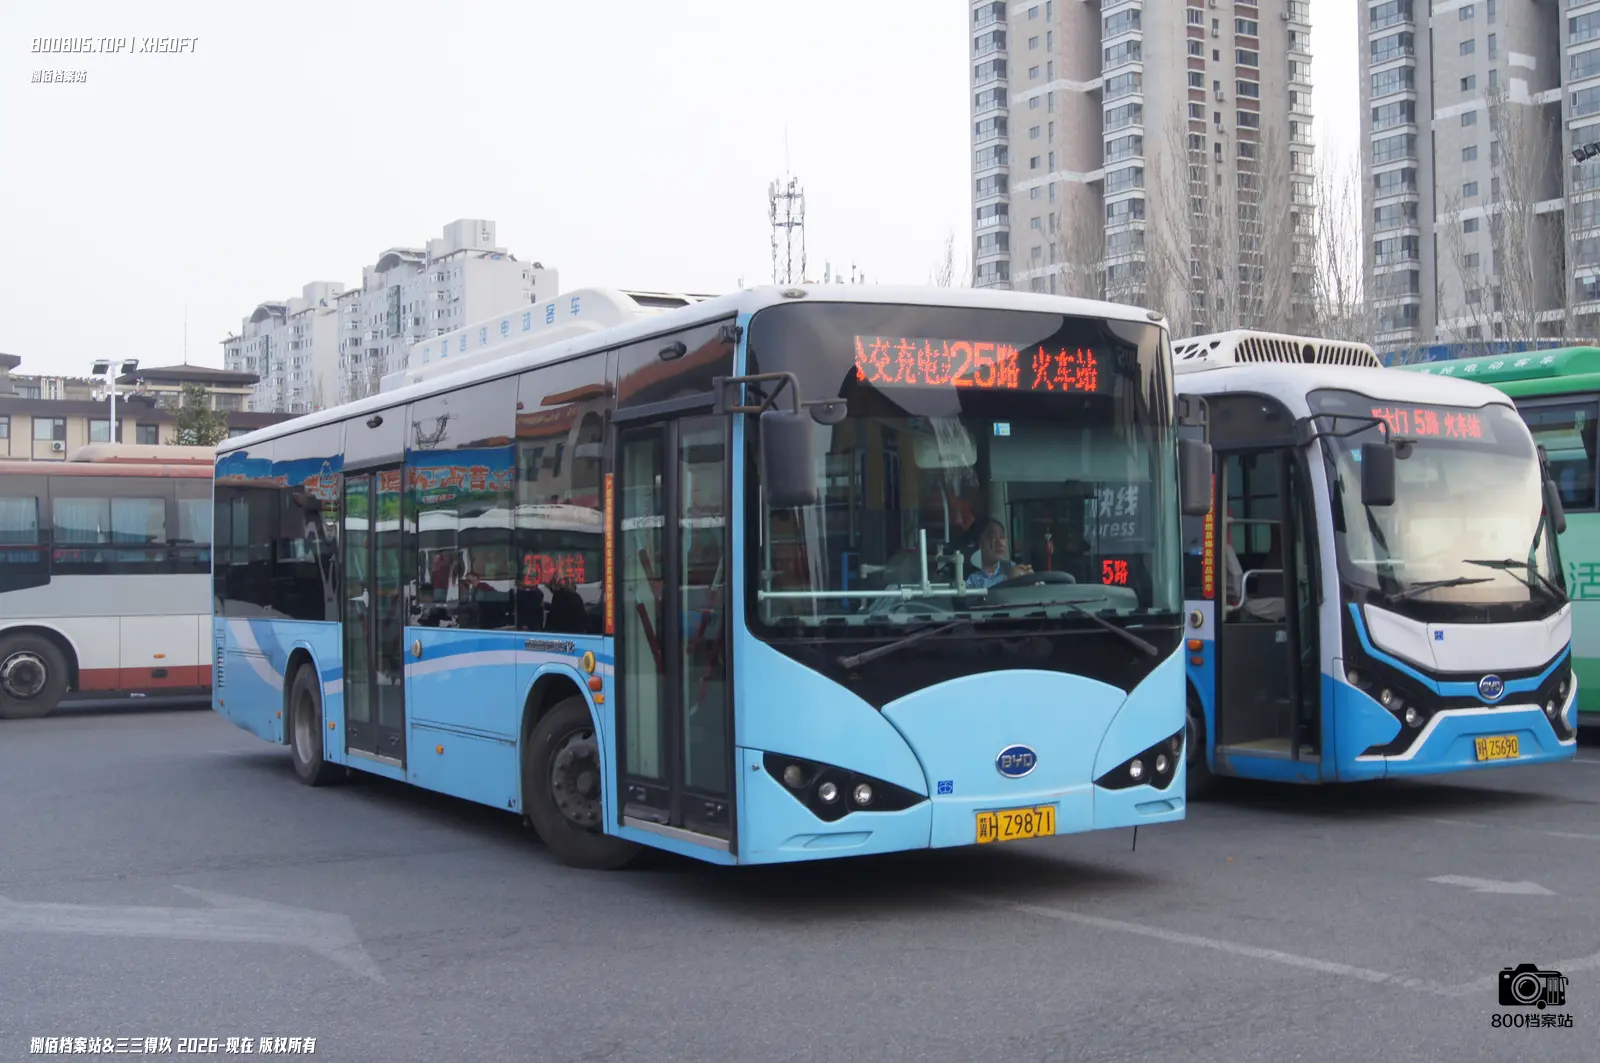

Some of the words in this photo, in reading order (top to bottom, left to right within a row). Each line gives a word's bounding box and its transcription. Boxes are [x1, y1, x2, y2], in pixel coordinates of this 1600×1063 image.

[1032, 346, 1097, 392] 火车站
[1414, 409, 1440, 436] 5路
[1444, 411, 1482, 439] 火车站
[1102, 559, 1129, 585] 5路
[1568, 561, 1600, 601] 活
[1482, 680, 1501, 692] BYD
[1001, 753, 1033, 768] BYD
